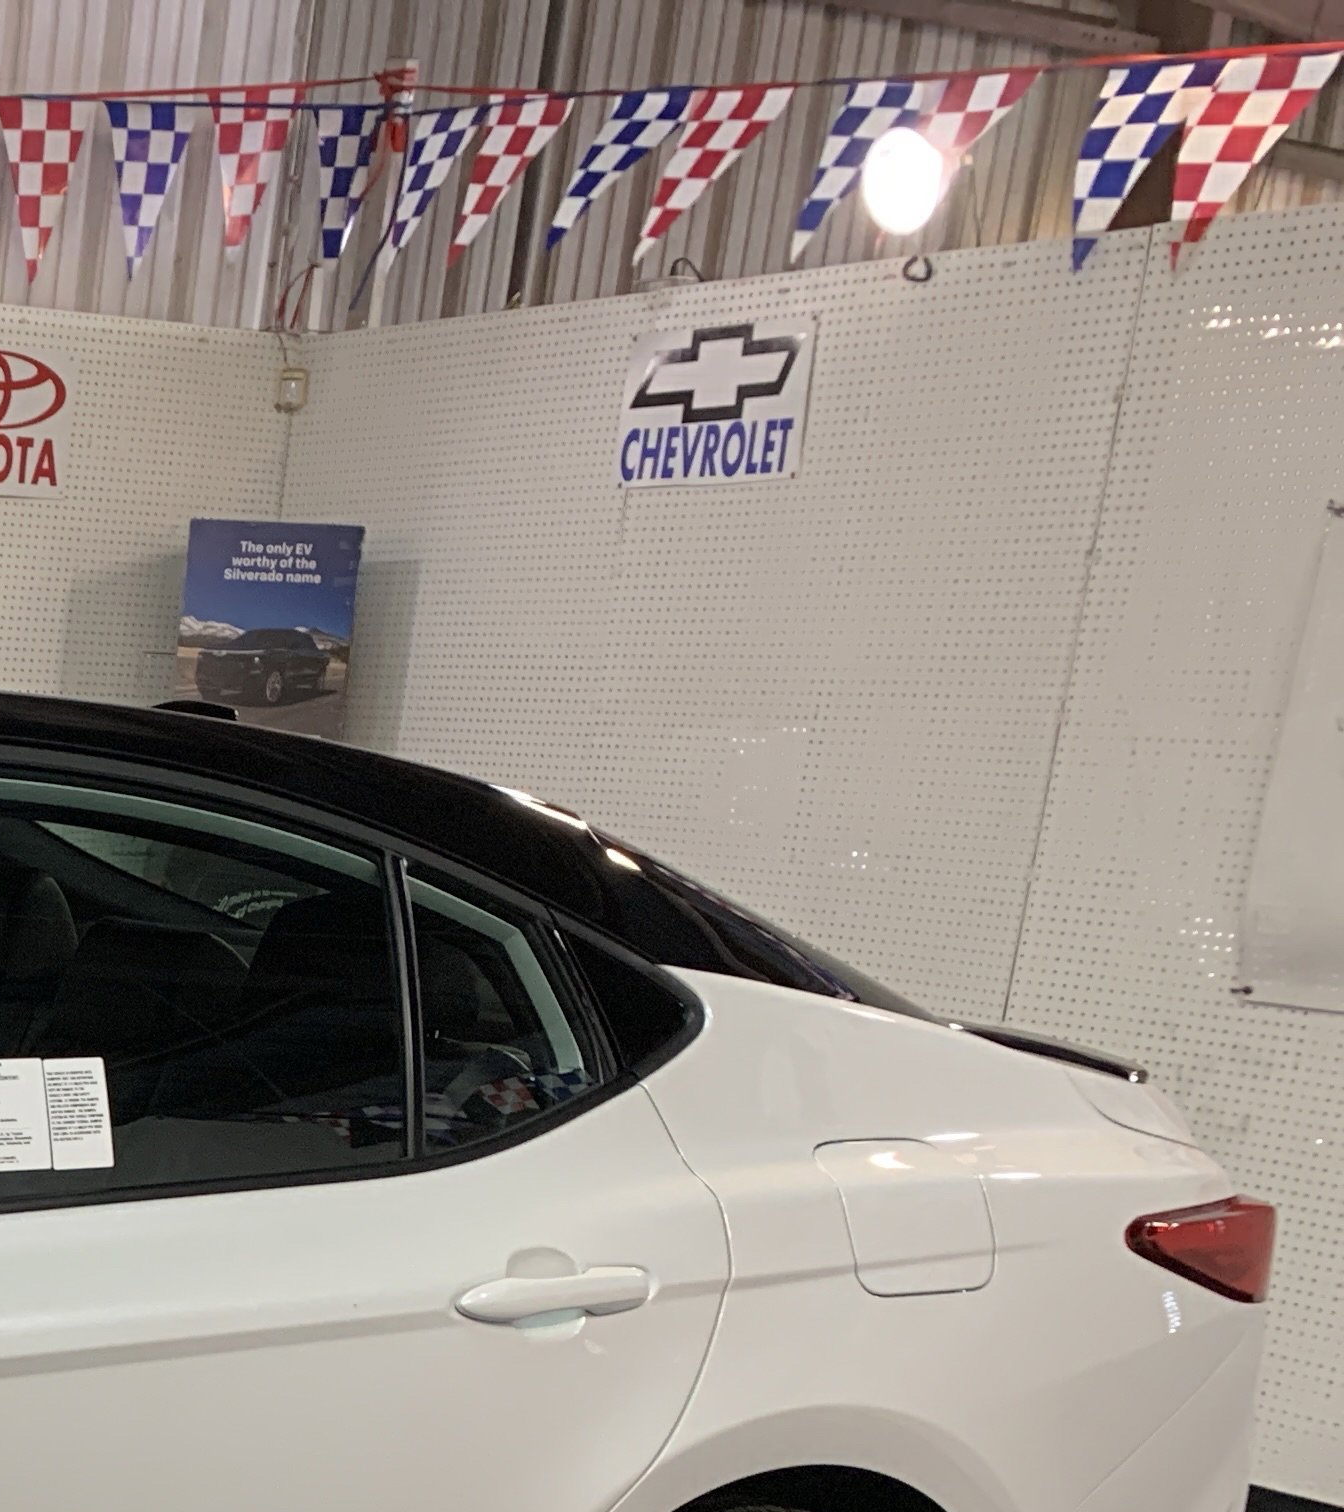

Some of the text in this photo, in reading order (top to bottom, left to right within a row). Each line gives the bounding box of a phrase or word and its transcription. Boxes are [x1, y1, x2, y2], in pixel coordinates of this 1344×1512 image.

[620, 417, 795, 482] CHEVROLET
[240, 540, 313, 556] The only EV
[232, 556, 317, 570] worthy of the
[224, 568, 322, 584] Silverado name
